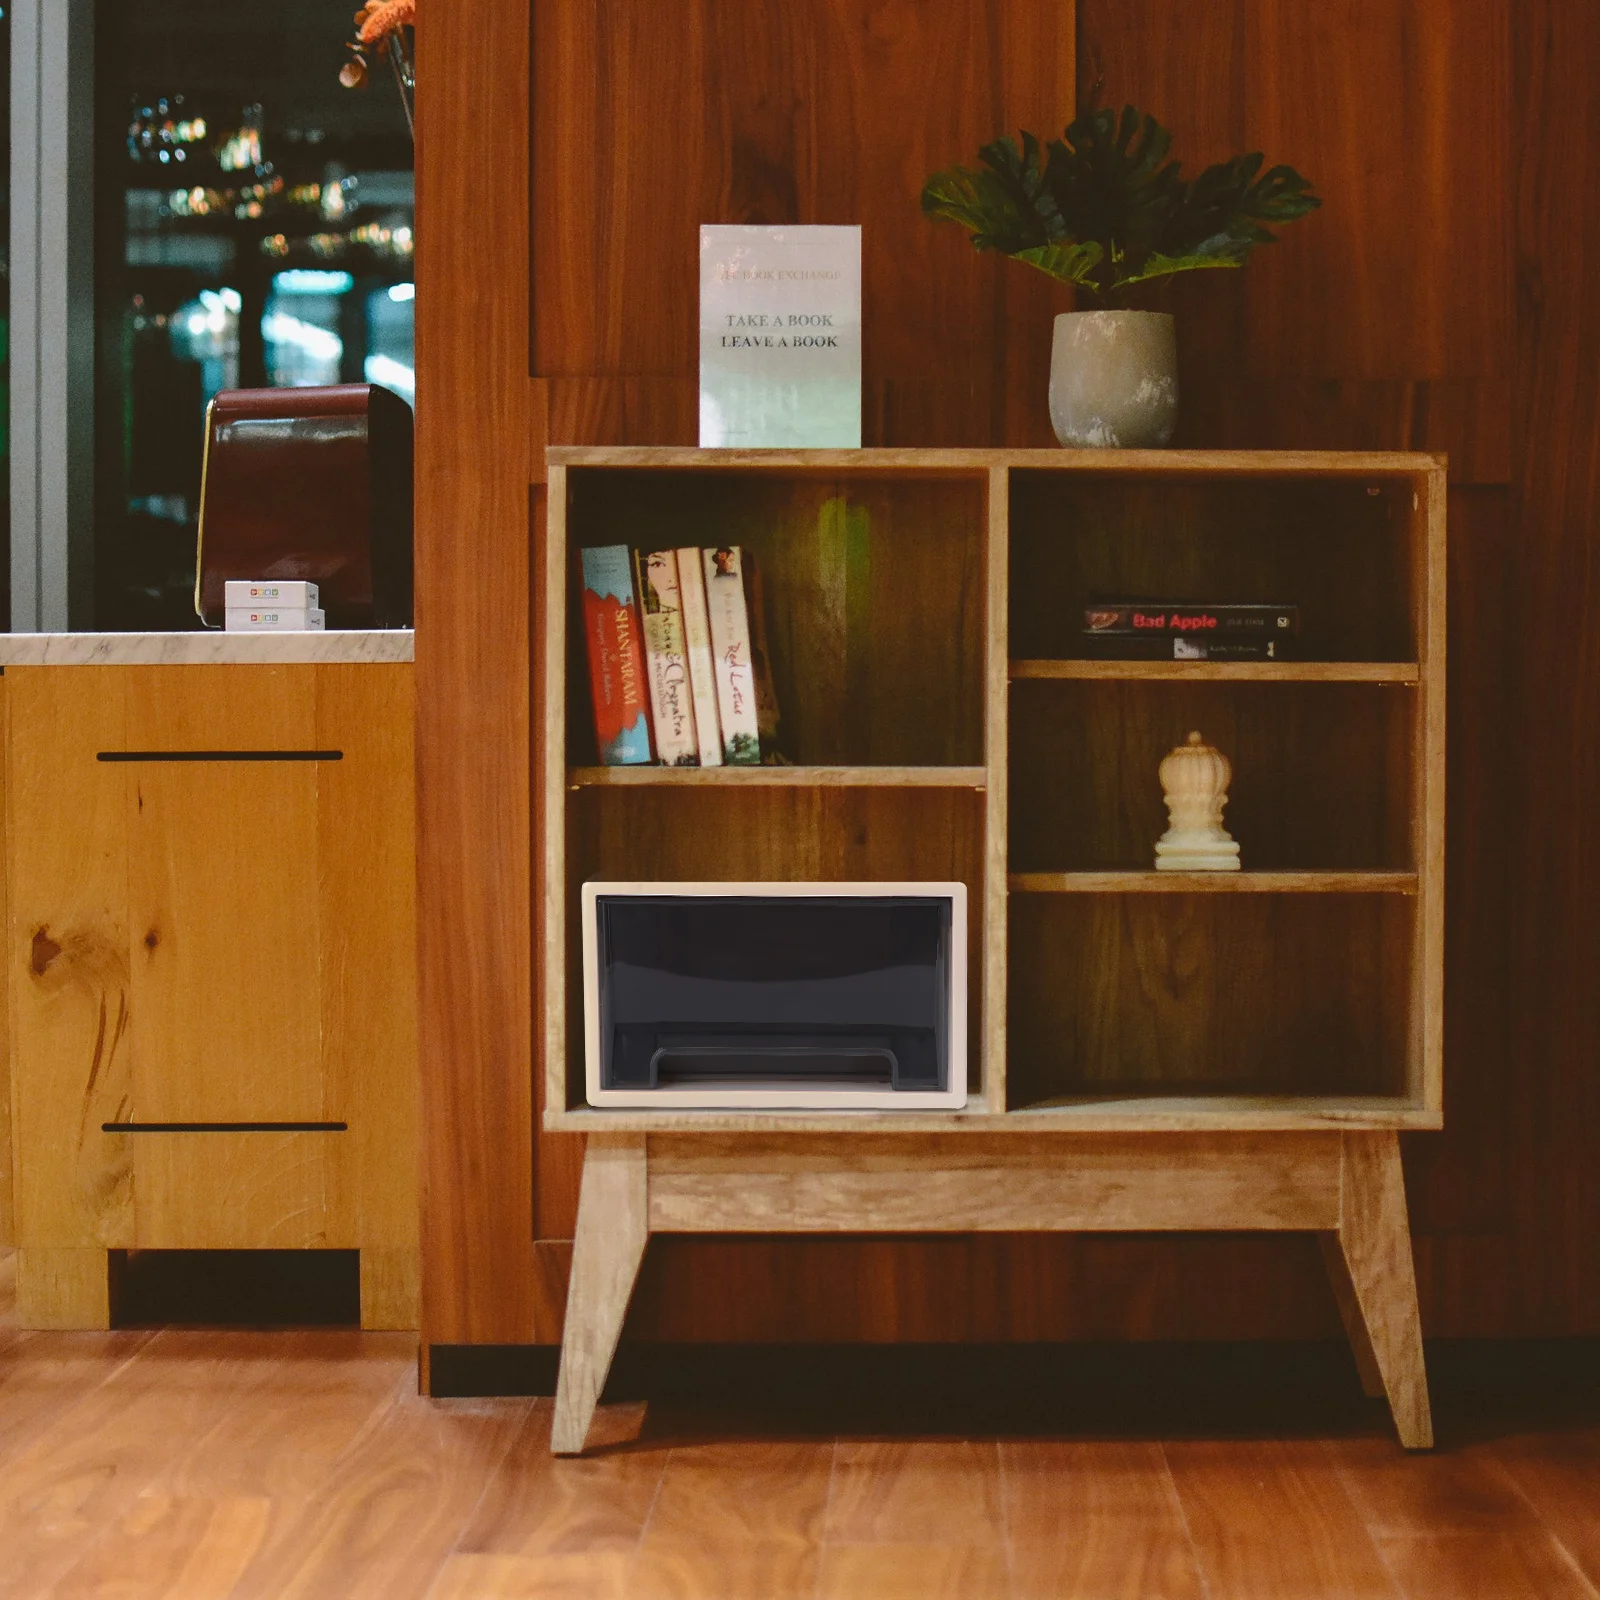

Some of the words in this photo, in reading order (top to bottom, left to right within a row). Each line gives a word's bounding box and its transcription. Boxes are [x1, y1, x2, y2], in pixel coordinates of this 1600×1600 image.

[743, 270, 772, 280] BOOK
[725, 314, 769, 327] TAKE
[773, 315, 784, 327] A
[788, 314, 834, 327] BOOK
[721, 335, 774, 348] LEAVE
[777, 336, 788, 348] A
[793, 335, 838, 348] BOOK
[1133, 614, 1165, 628] Bad
[1169, 614, 1217, 631] Apple
[614, 608, 637, 705] SHANTARAM
[723, 641, 747, 669] Red
[663, 662, 684, 737] Cleopatra
[729, 671, 744, 716] Lotus
